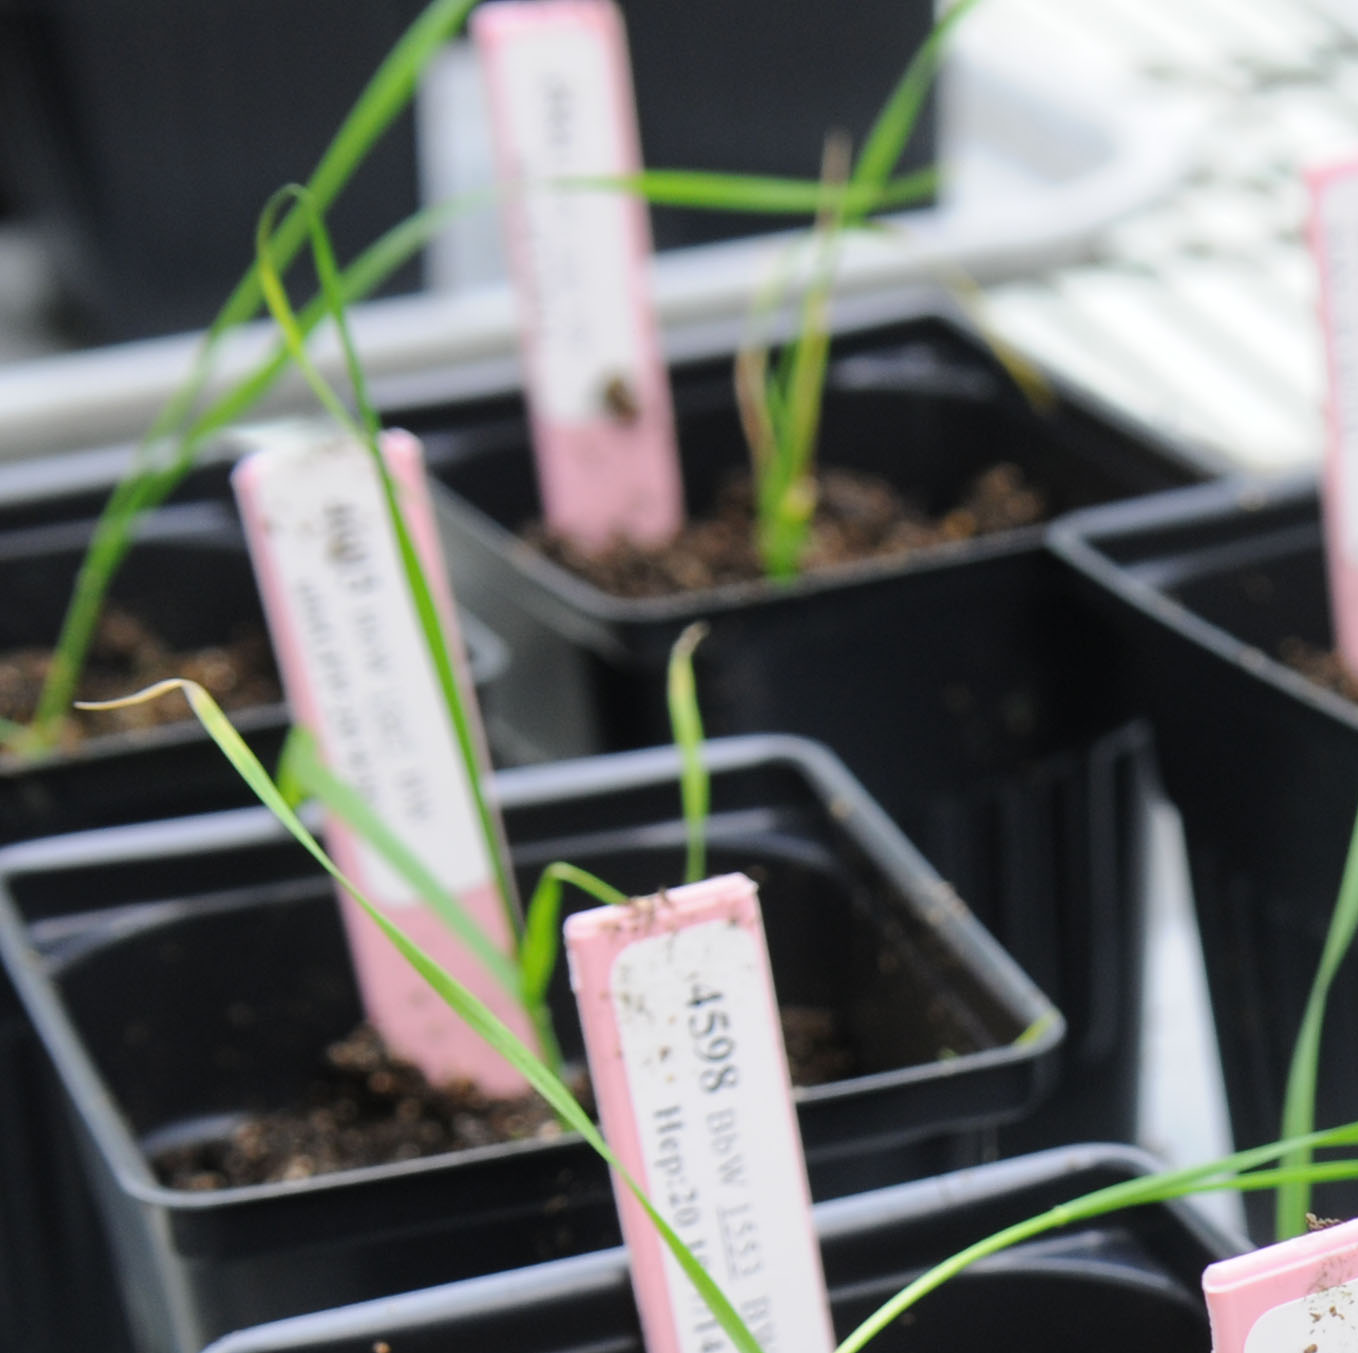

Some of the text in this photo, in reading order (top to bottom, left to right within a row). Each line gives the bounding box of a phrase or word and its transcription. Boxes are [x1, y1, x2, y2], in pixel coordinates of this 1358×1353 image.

[685, 987, 739, 1095] 4598
[653, 1104, 700, 1229] Hep:20
[706, 1108, 749, 1190] BbW
